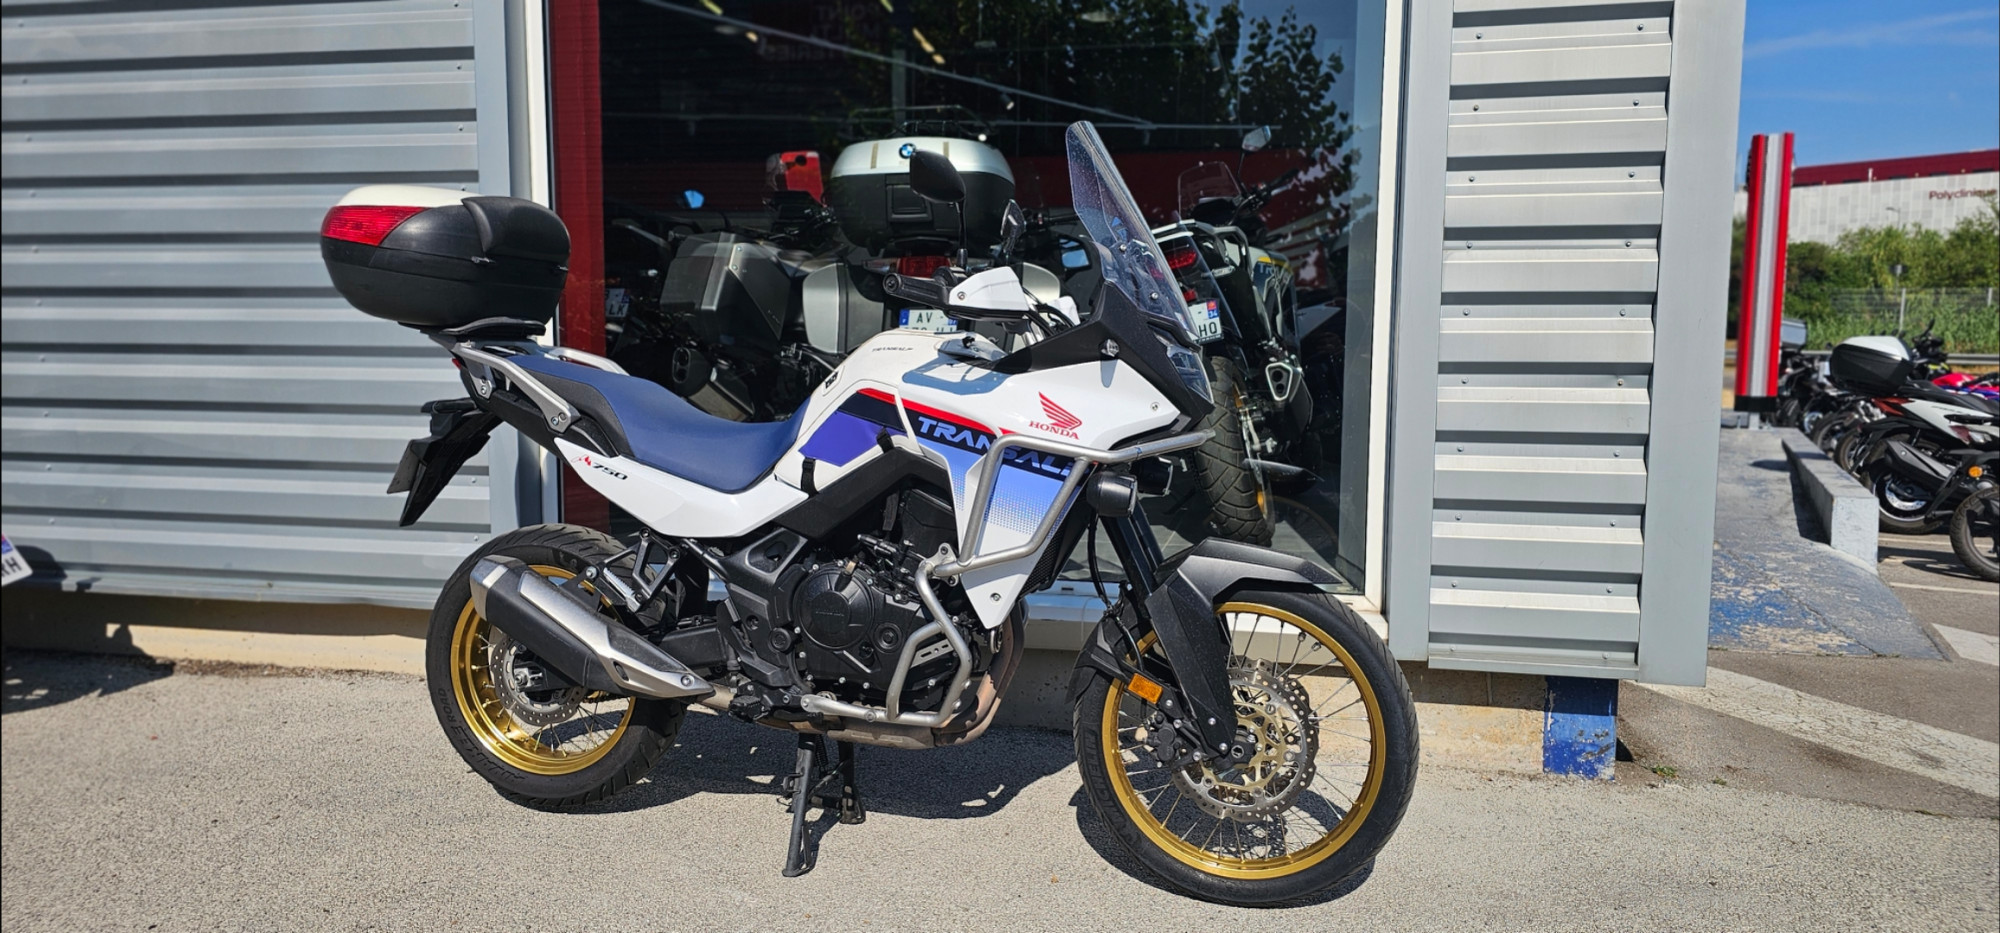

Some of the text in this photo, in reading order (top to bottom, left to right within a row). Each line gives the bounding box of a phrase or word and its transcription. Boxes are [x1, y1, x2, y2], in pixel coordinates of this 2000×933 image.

[1928, 188, 1997, 200] Polyclinique
[917, 312, 933, 324] AV
[1028, 420, 1080, 441] HONDA
[593, 462, 628, 480] 750
[437, 687, 457, 723] ROAD
